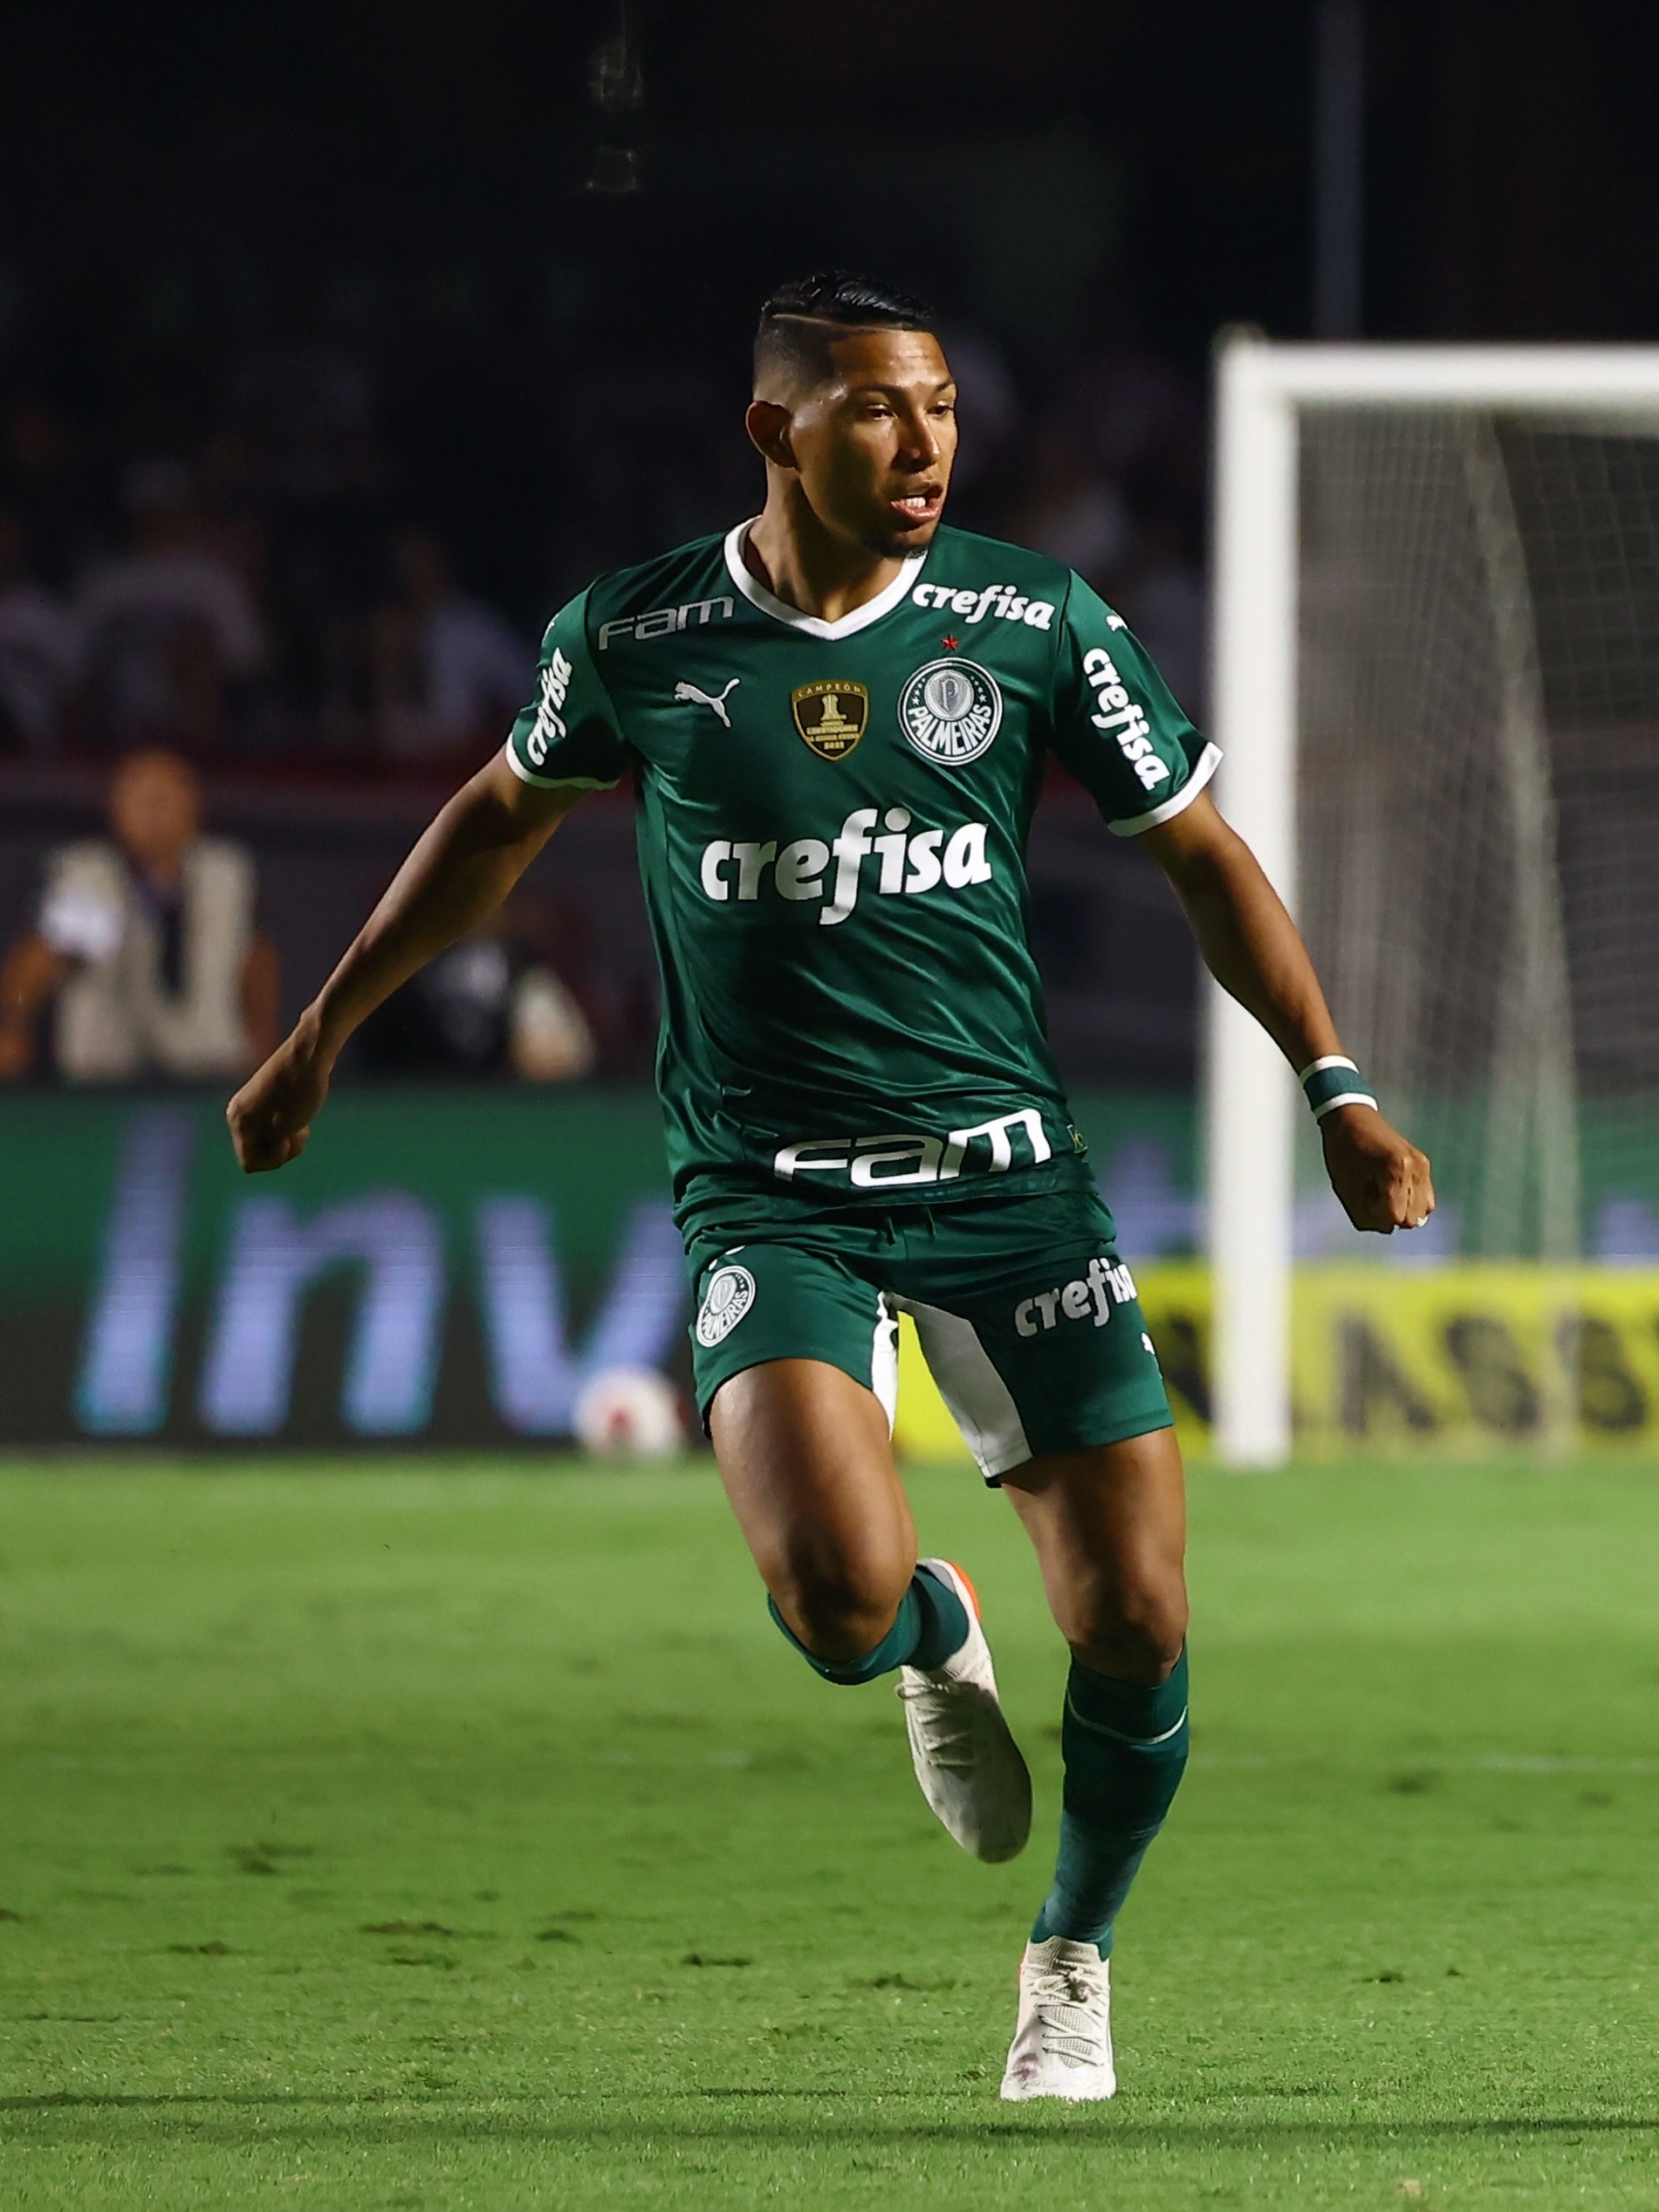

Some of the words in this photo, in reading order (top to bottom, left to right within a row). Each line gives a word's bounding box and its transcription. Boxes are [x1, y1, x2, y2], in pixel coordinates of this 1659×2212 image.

[912, 583, 1056, 631] crefisa
[527, 647, 573, 766] crefisa
[908, 704, 992, 756] PALMEIRAS
[1083, 648, 1170, 791] crefisa
[701, 807, 992, 925] crefisa
